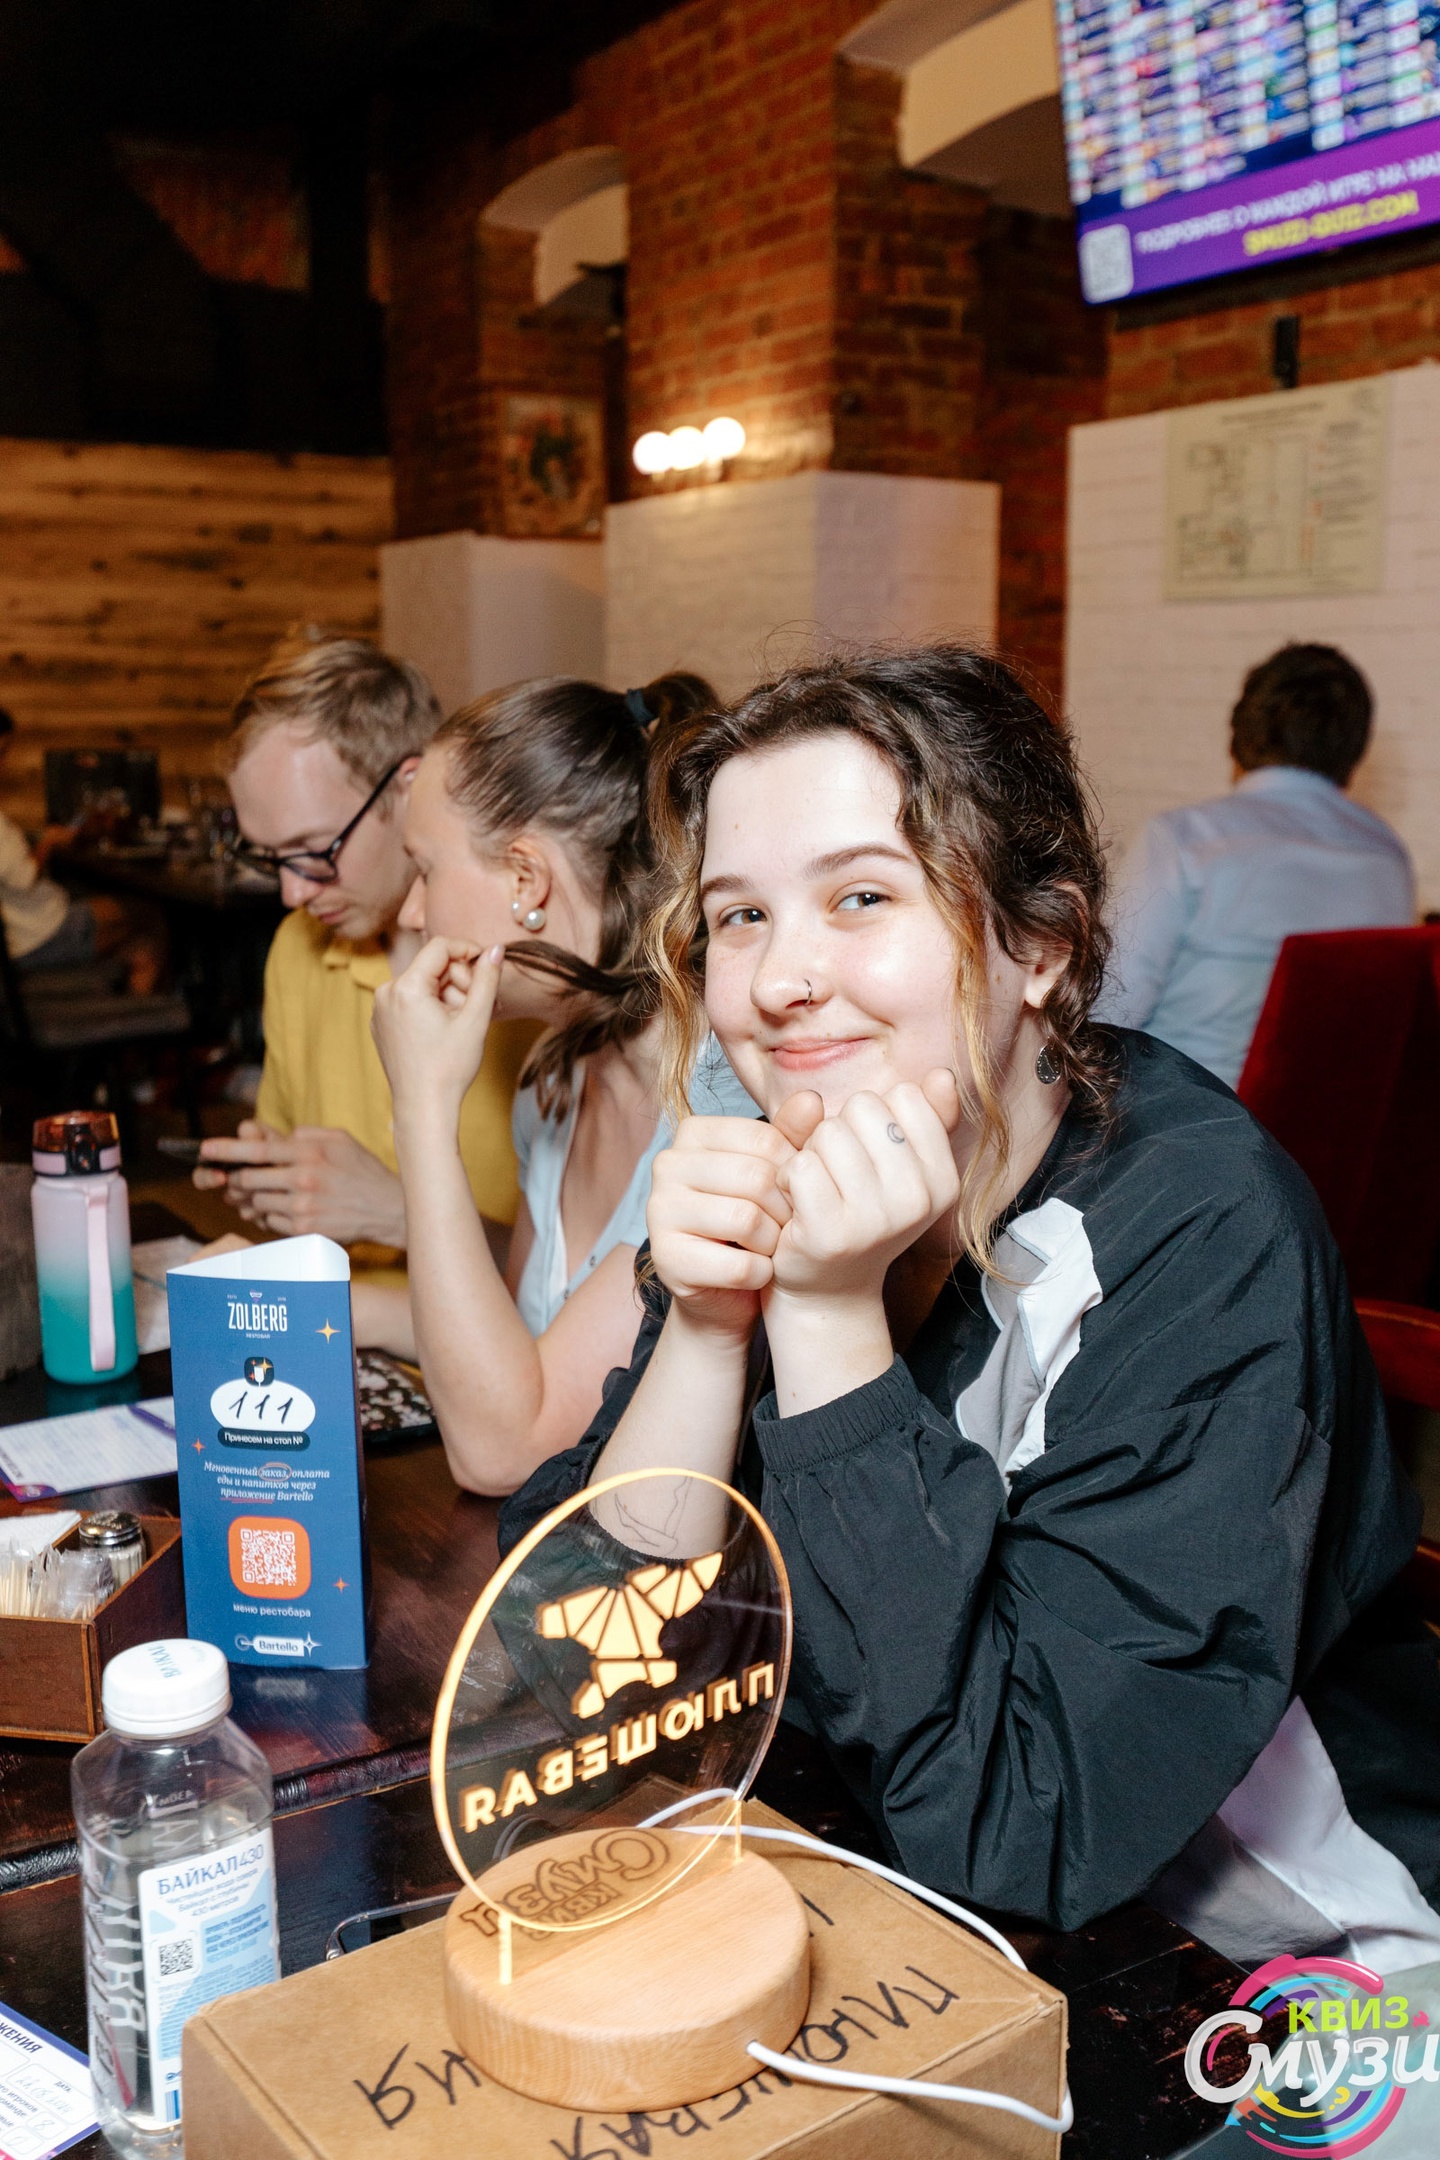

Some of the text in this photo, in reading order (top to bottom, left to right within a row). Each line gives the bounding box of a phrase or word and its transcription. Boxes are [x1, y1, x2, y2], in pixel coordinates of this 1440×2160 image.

[1327, 170, 1377, 200] ИГРЕ
[227, 1302, 288, 1332] ZOLBERG
[229, 1391, 293, 1424] 111
[225, 1432, 263, 1446] Принесем
[263, 1435, 273, 1444] на
[274, 1435, 293, 1445] стол
[204, 1461, 330, 1479] Мгновенный заказ, оплата
[217, 1475, 233, 1486] еды
[241, 1479, 289, 1490] напитков
[291, 1482, 317, 1492] через
[220, 1487, 314, 1502] приложение Bartello
[259, 1605, 311, 1618] рестобара
[259, 1640, 299, 1652] Bartello
[7, 2091, 38, 2113] игроков
